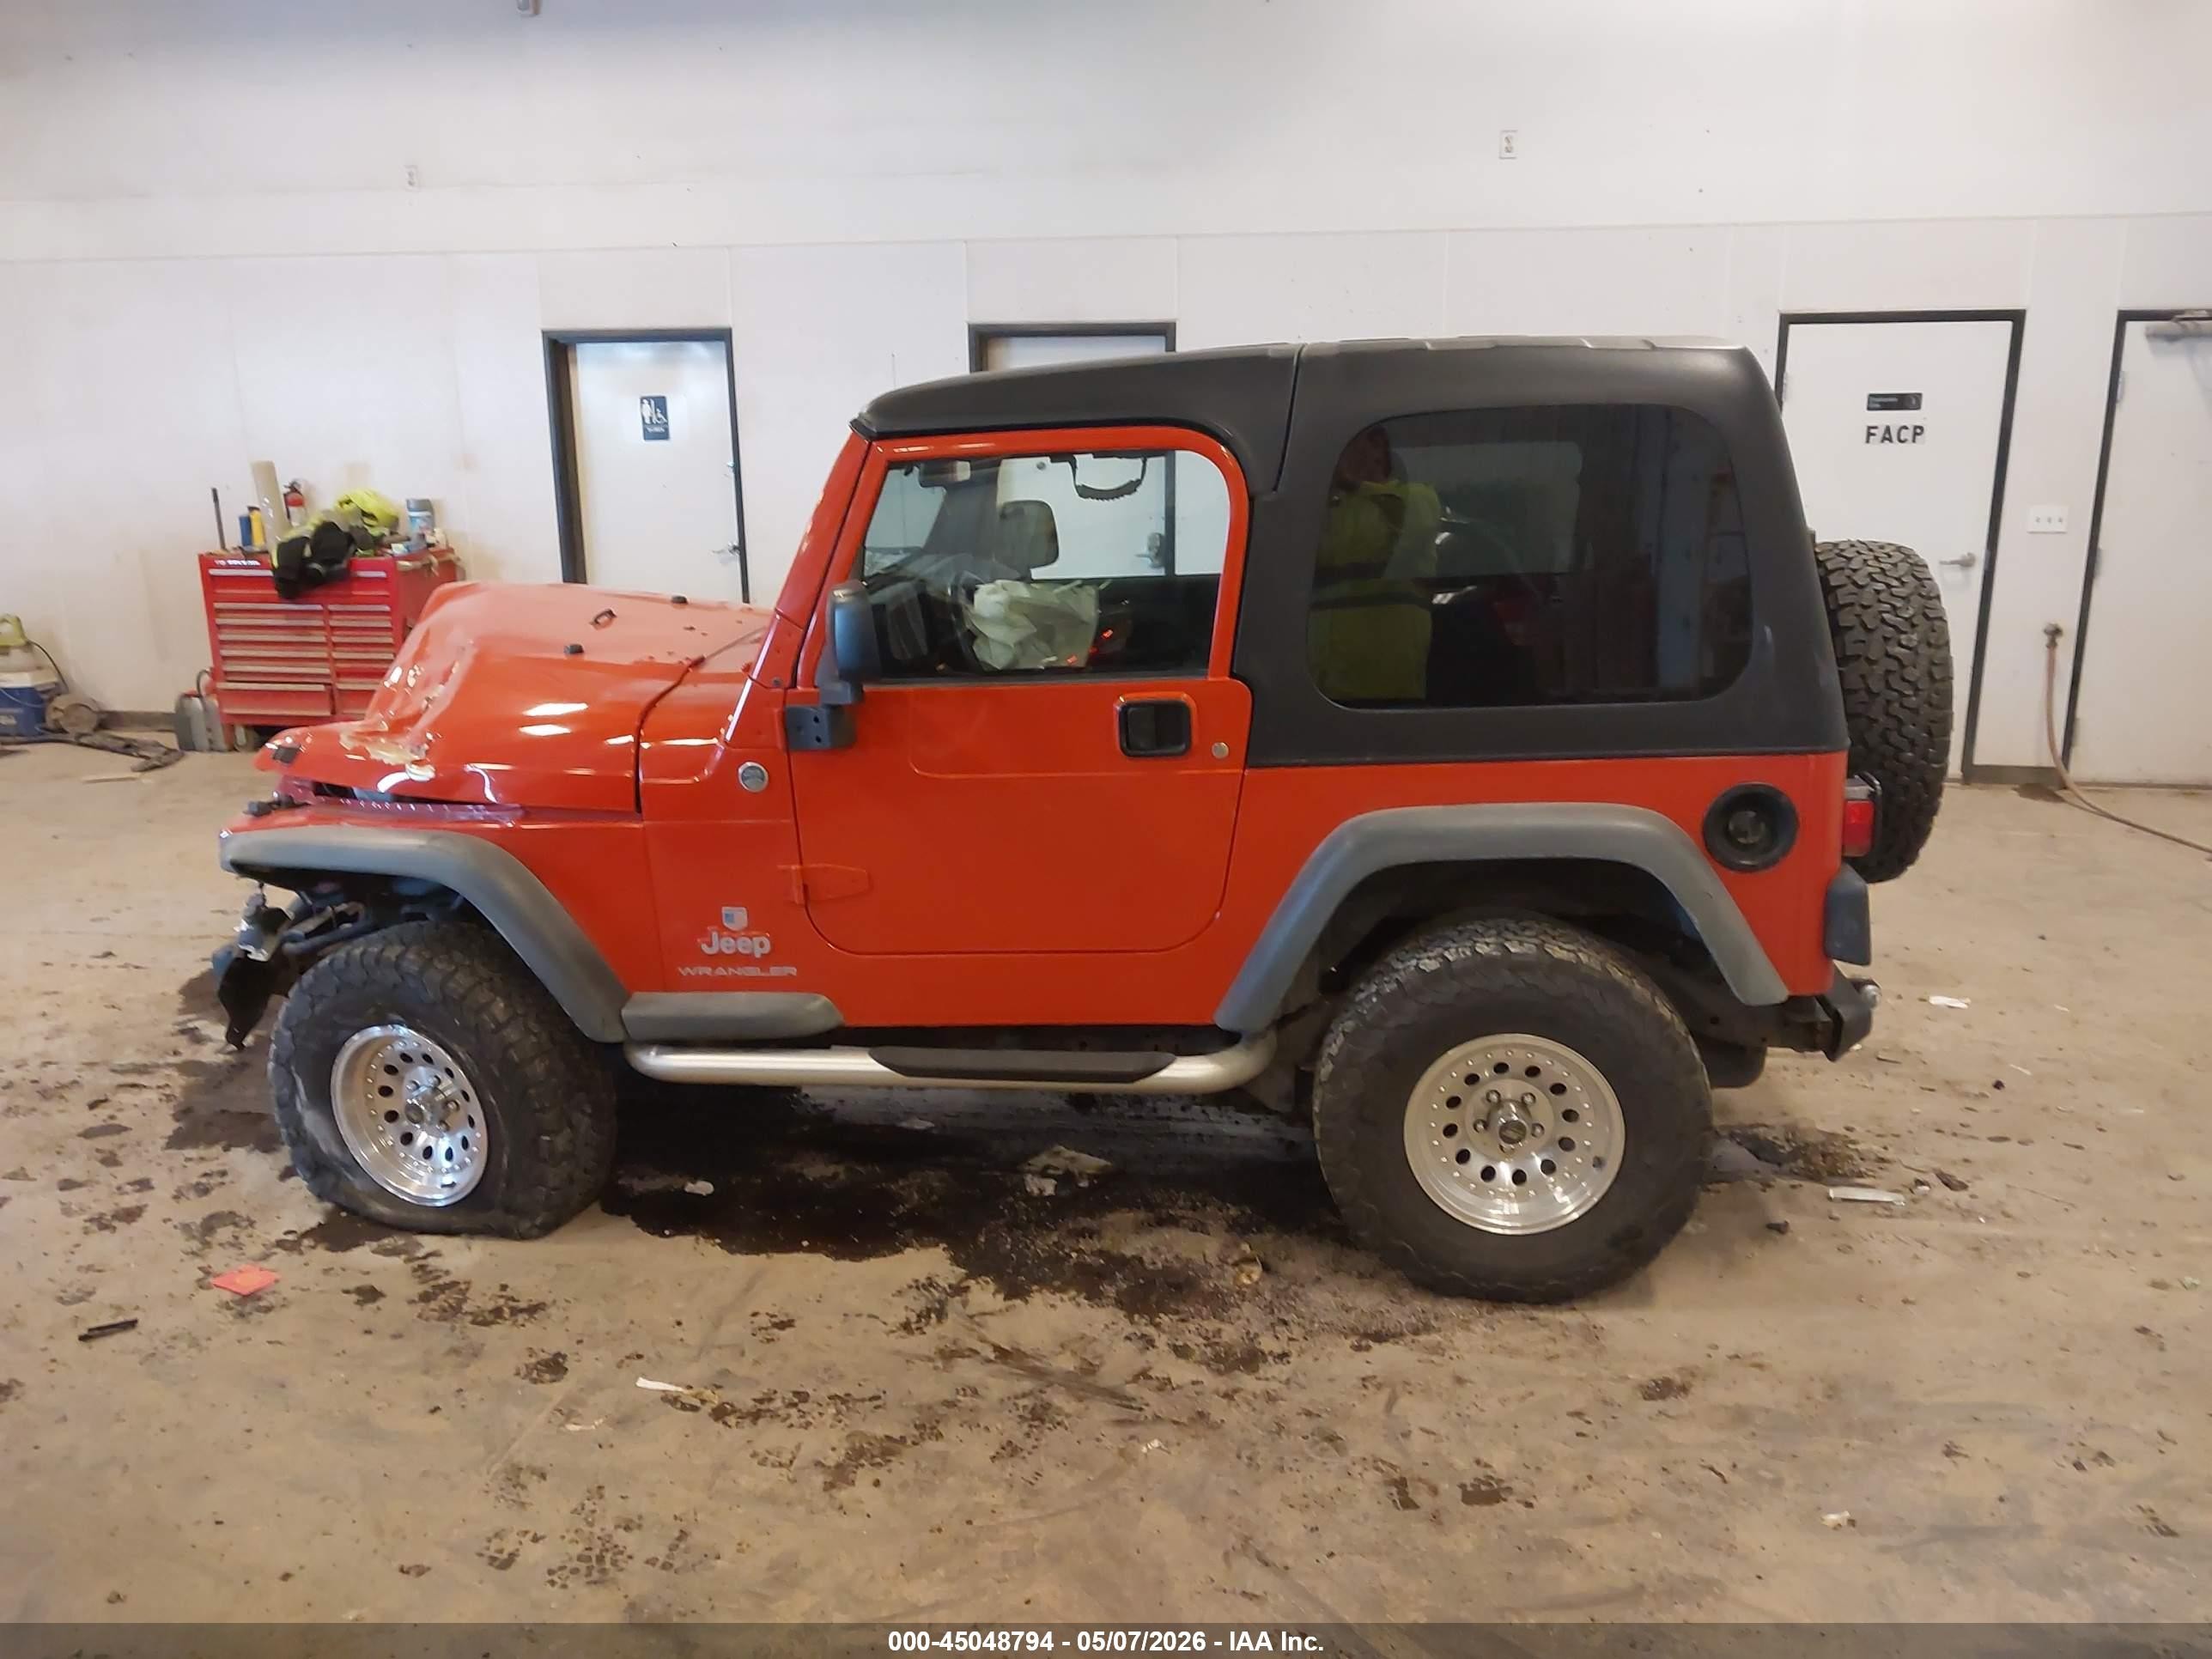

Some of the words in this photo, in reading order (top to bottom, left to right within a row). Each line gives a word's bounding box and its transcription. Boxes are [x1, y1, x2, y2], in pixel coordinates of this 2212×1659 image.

[1866, 425, 1924, 444] FACP
[700, 931, 771, 958] Jeep
[678, 966, 798, 976] WRANGLER
